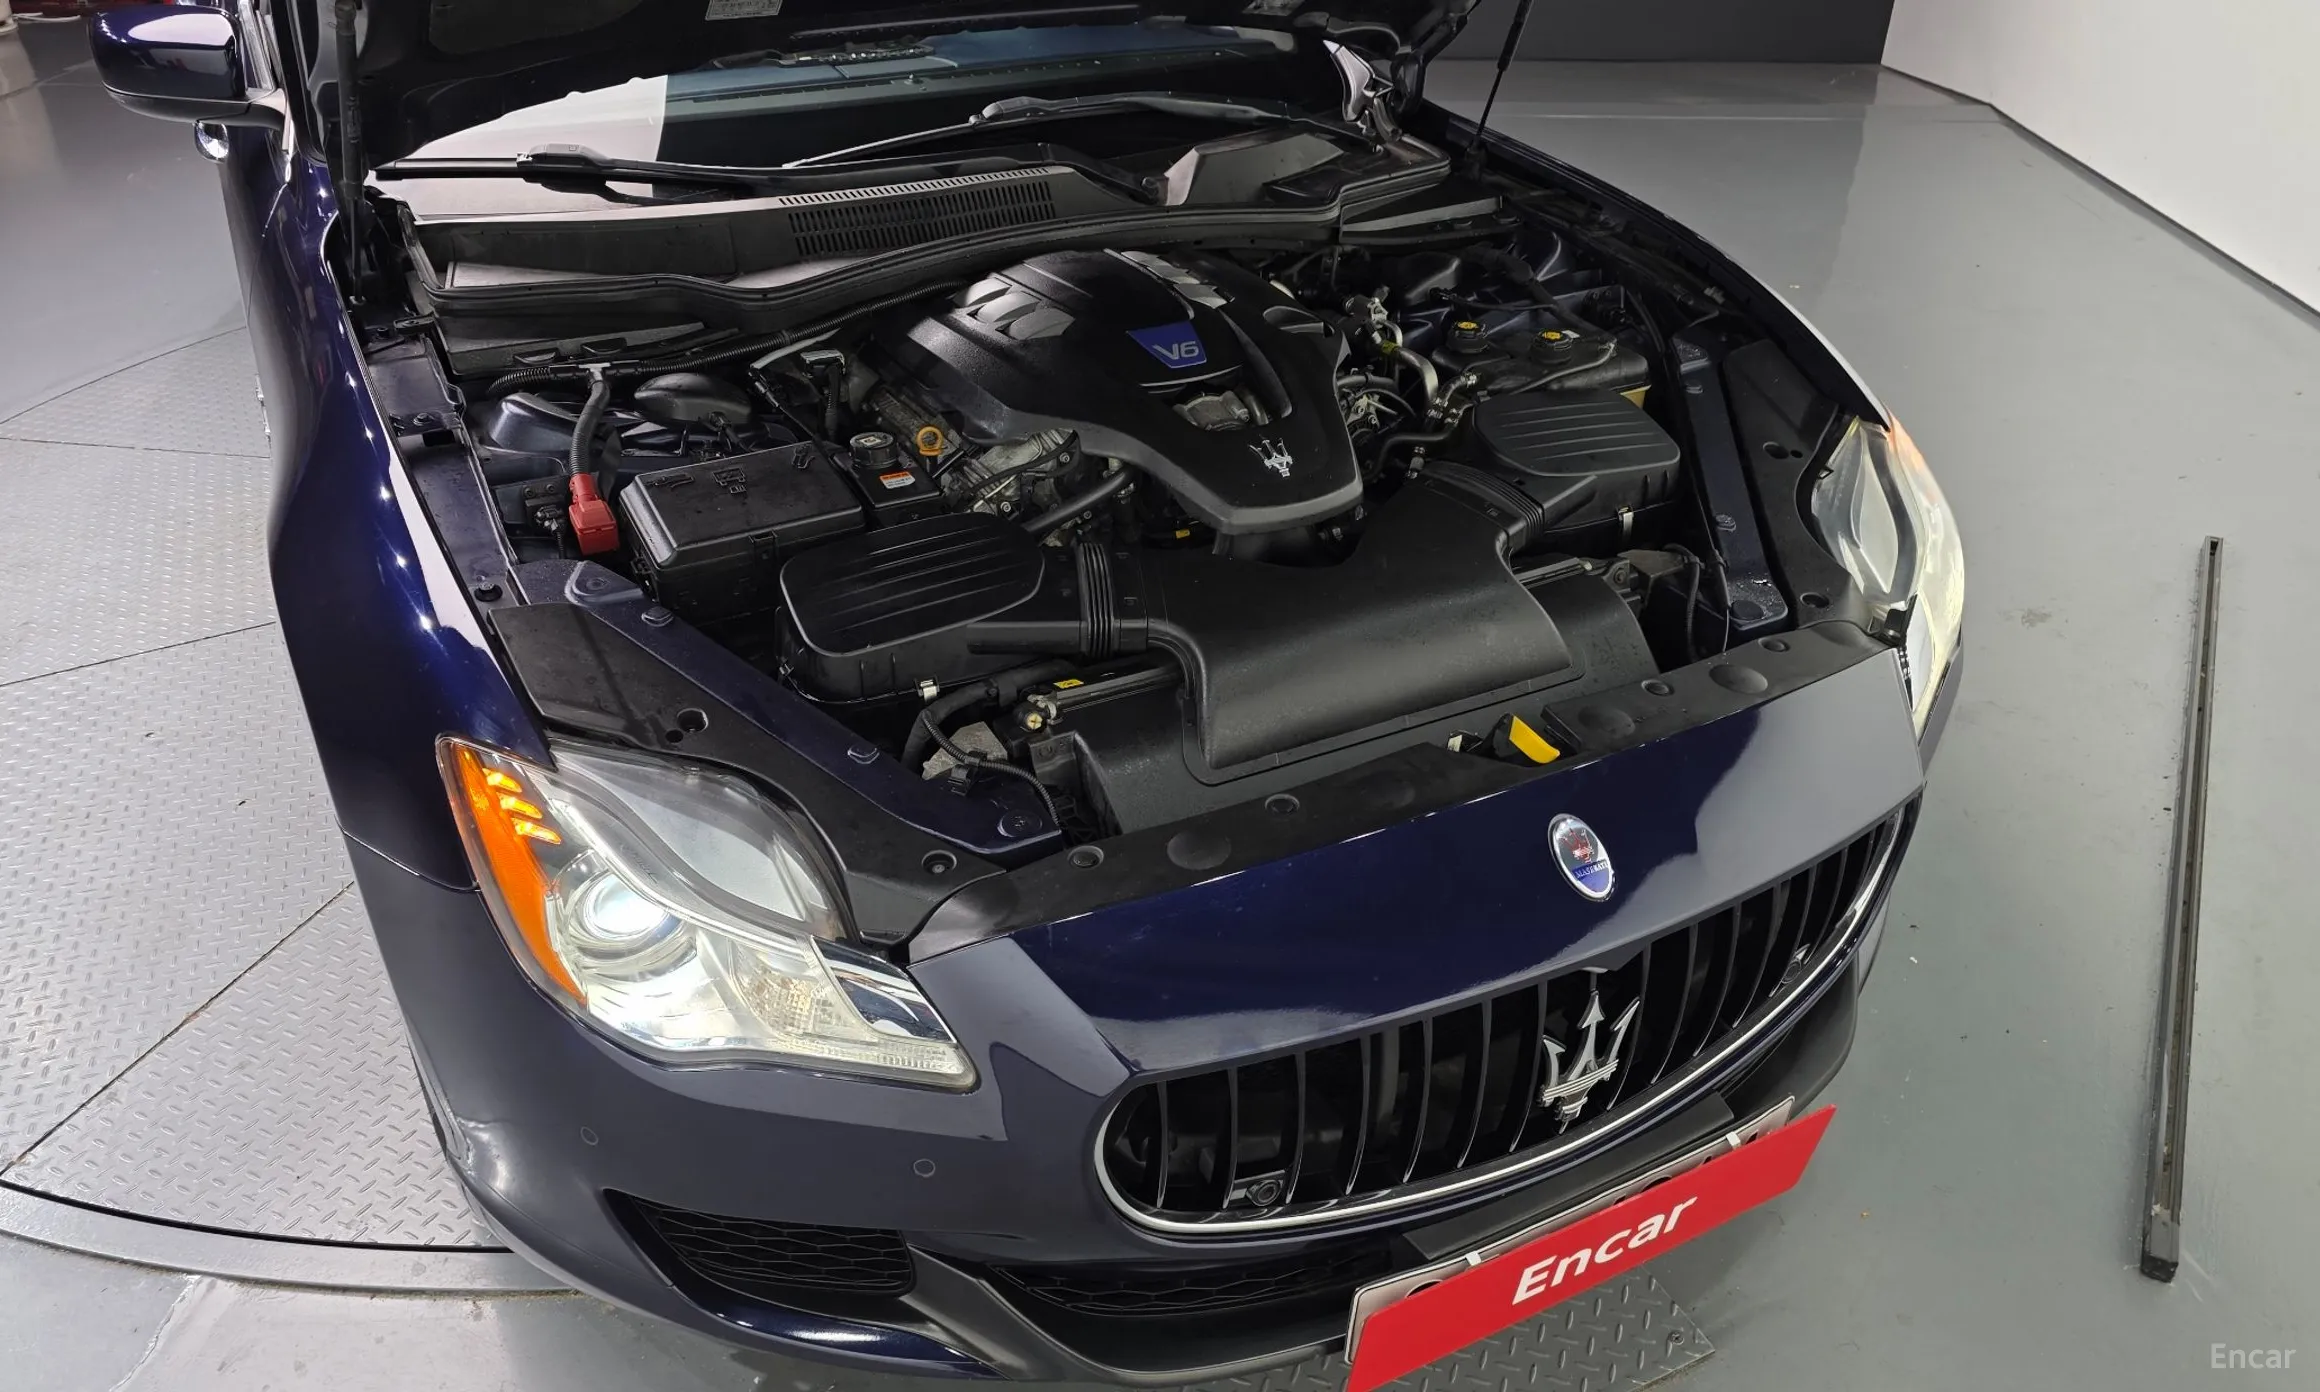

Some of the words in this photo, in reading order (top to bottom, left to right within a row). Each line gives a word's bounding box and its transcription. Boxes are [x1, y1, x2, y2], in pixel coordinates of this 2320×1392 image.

[1152, 341, 1199, 360] V6
[1575, 861, 1609, 879] MASERATI
[1511, 1196, 1698, 1306] Encar
